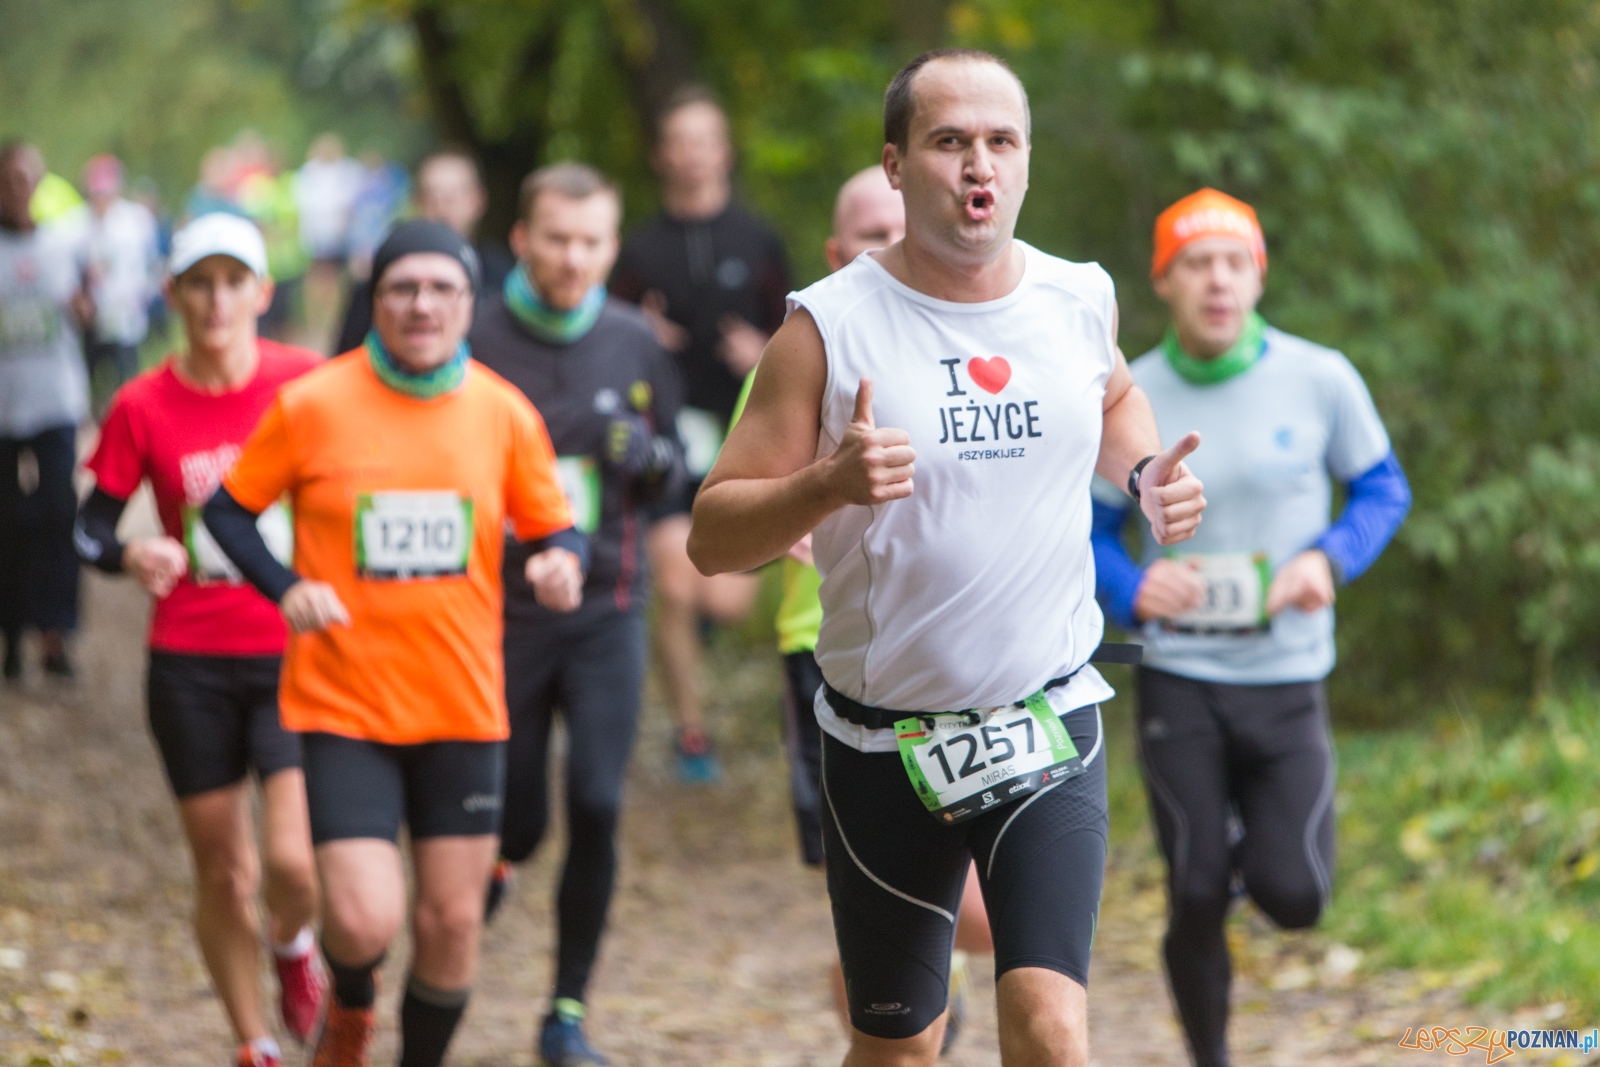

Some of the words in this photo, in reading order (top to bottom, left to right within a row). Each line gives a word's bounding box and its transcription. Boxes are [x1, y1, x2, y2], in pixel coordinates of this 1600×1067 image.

[940, 358, 966, 396] I
[939, 400, 1042, 444] JEŻYCE
[958, 447, 1025, 461] #SZYBKIJEZ
[378, 517, 456, 553] 1210
[928, 717, 1035, 784] 1257
[981, 765, 1016, 786] MIRAS
